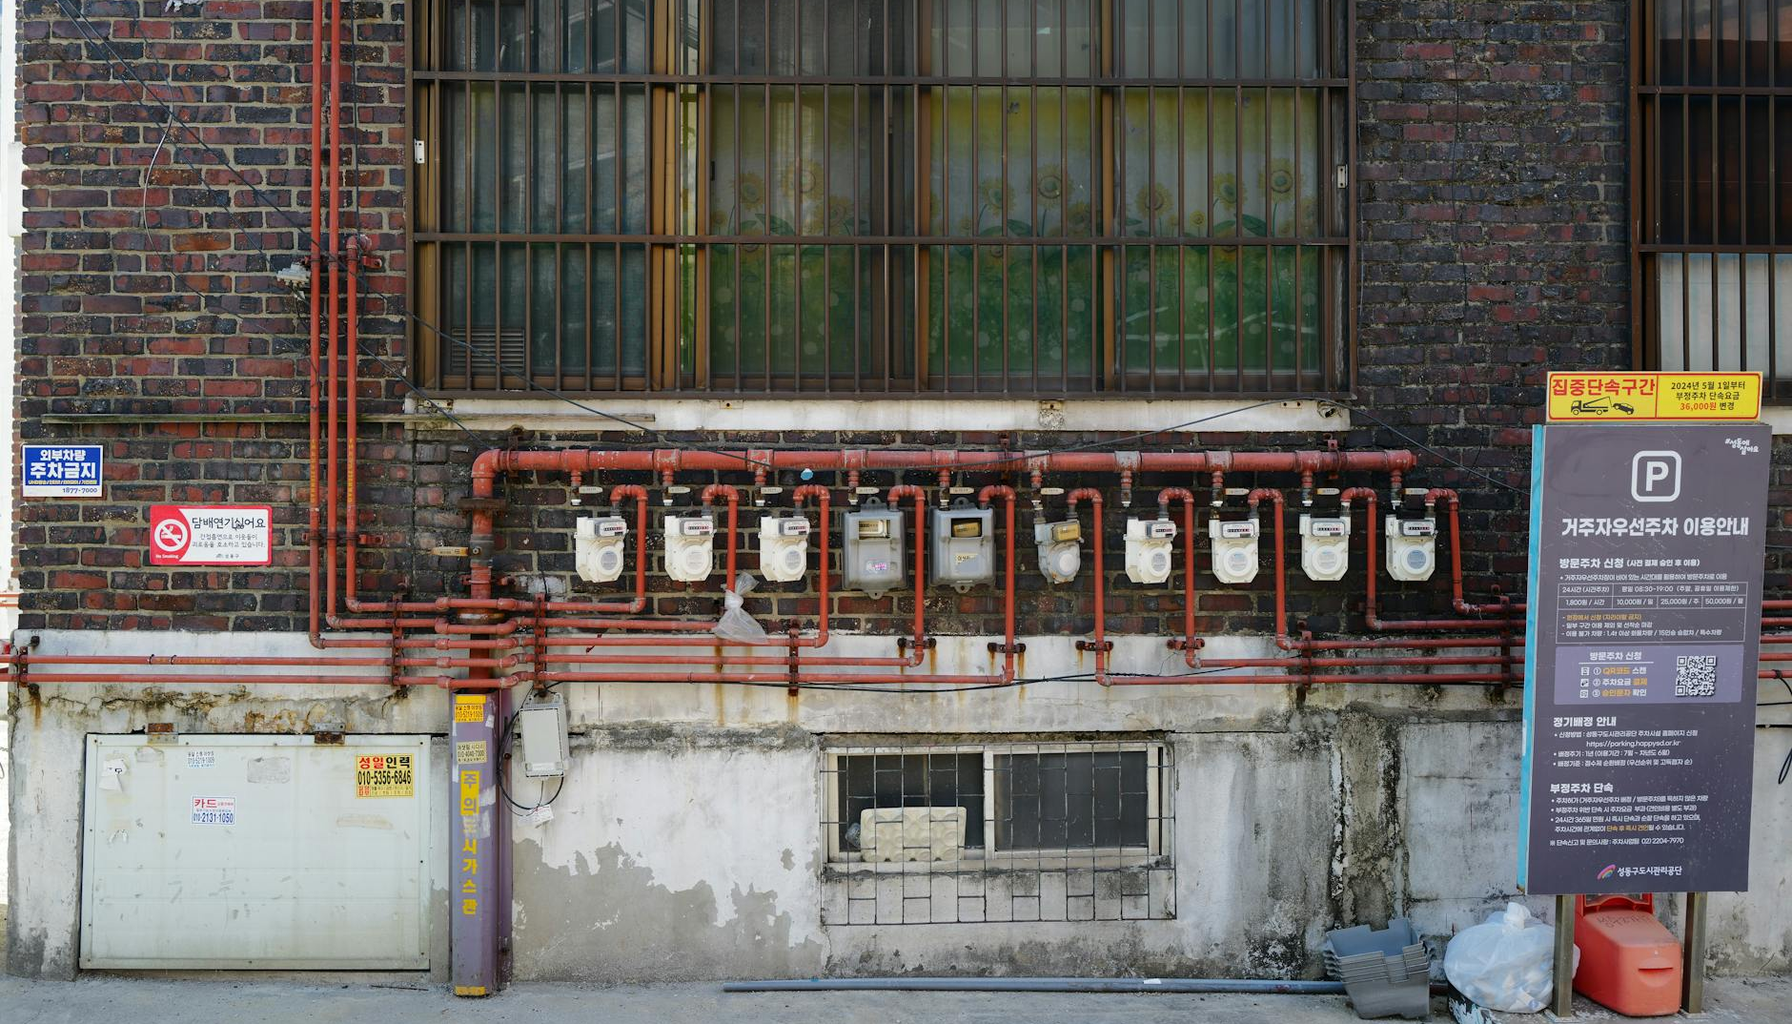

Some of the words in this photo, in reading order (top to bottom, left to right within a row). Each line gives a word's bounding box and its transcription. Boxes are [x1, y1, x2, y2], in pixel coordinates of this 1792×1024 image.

[1552, 378, 1655, 396] 집중단속구간
[1671, 381, 1700, 390] 2024년
[1702, 381, 1715, 390] 5월
[1717, 381, 1745, 390] 1일부터
[1676, 392, 1707, 400] 부정주차
[1709, 392, 1740, 400] 단속요금
[1680, 402, 1717, 411] 36,000원
[1719, 402, 1735, 411] 변경
[40, 449, 86, 462] 외부차량
[30, 462, 96, 479] 주차금지
[1645, 461, 1669, 491] P
[192, 517, 266, 531] 담배연기싫어요
[1561, 517, 1678, 536] 거주자우선주차
[1683, 517, 1749, 536] 이용안내
[1560, 558, 1600, 568] 방문주차
[1604, 558, 1624, 568] 신청
[1626, 559, 1643, 567] (사전
[1683, 558, 1700, 566] 이용)
[1590, 652, 1623, 661] 방문주차
[1626, 652, 1642, 660] 신청
[1602, 678, 1631, 686] 주차요금
[1553, 717, 1593, 727] 정기배정
[1596, 716, 1616, 727] 안내
[359, 756, 410, 769] 성일인력
[358, 770, 412, 785] 010-5356-6846
[1550, 783, 1591, 794] 부정주차
[1594, 783, 1613, 793] 단속
[194, 799, 217, 808] 카드
[193, 812, 234, 823] 010-2131-1050
[1617, 866, 1682, 877] 성동구도시관리공단
